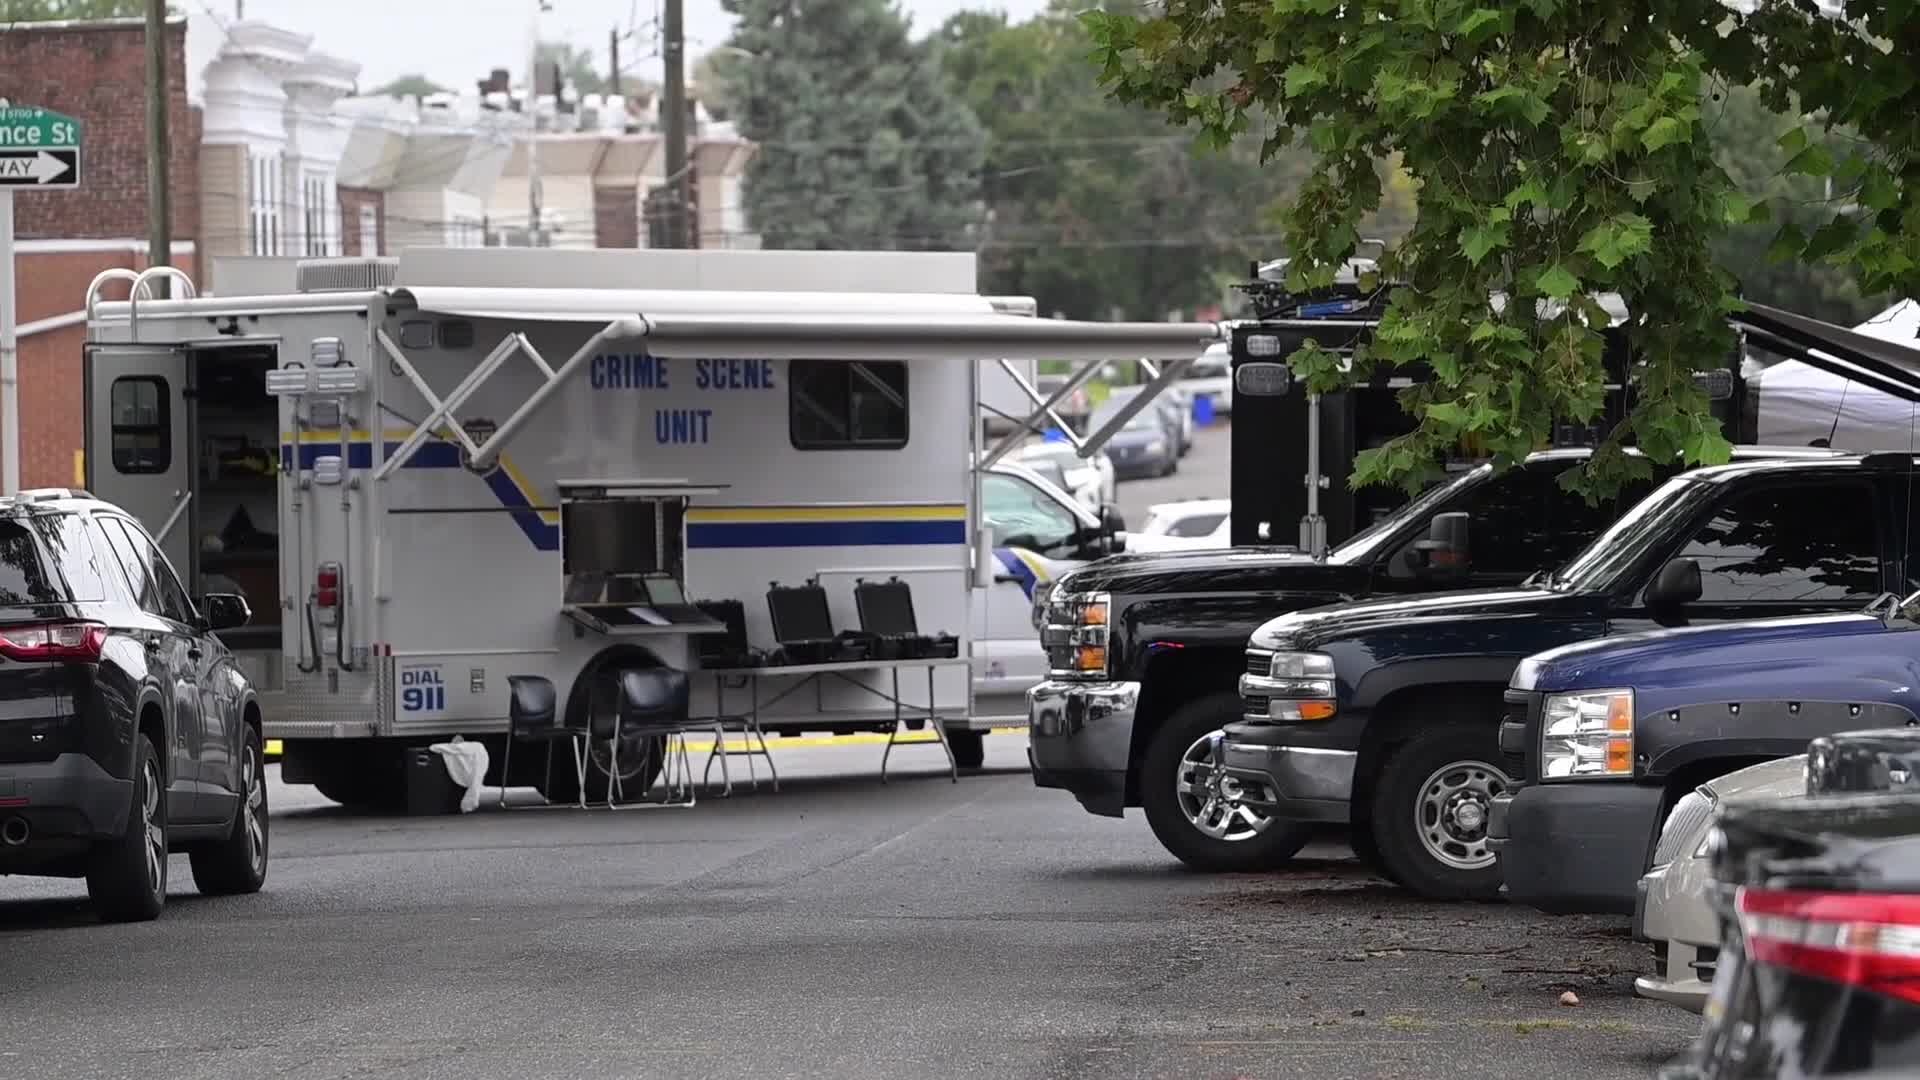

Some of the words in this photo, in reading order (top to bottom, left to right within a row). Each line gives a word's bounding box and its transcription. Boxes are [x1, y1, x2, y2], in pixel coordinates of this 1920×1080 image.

[52, 122, 75, 144] St
[590, 354, 669, 390] CRIME
[695, 357, 775, 390] SCENE
[655, 409, 713, 444] UNIT
[401, 670, 445, 686] DIAL
[402, 687, 444, 711] 911
